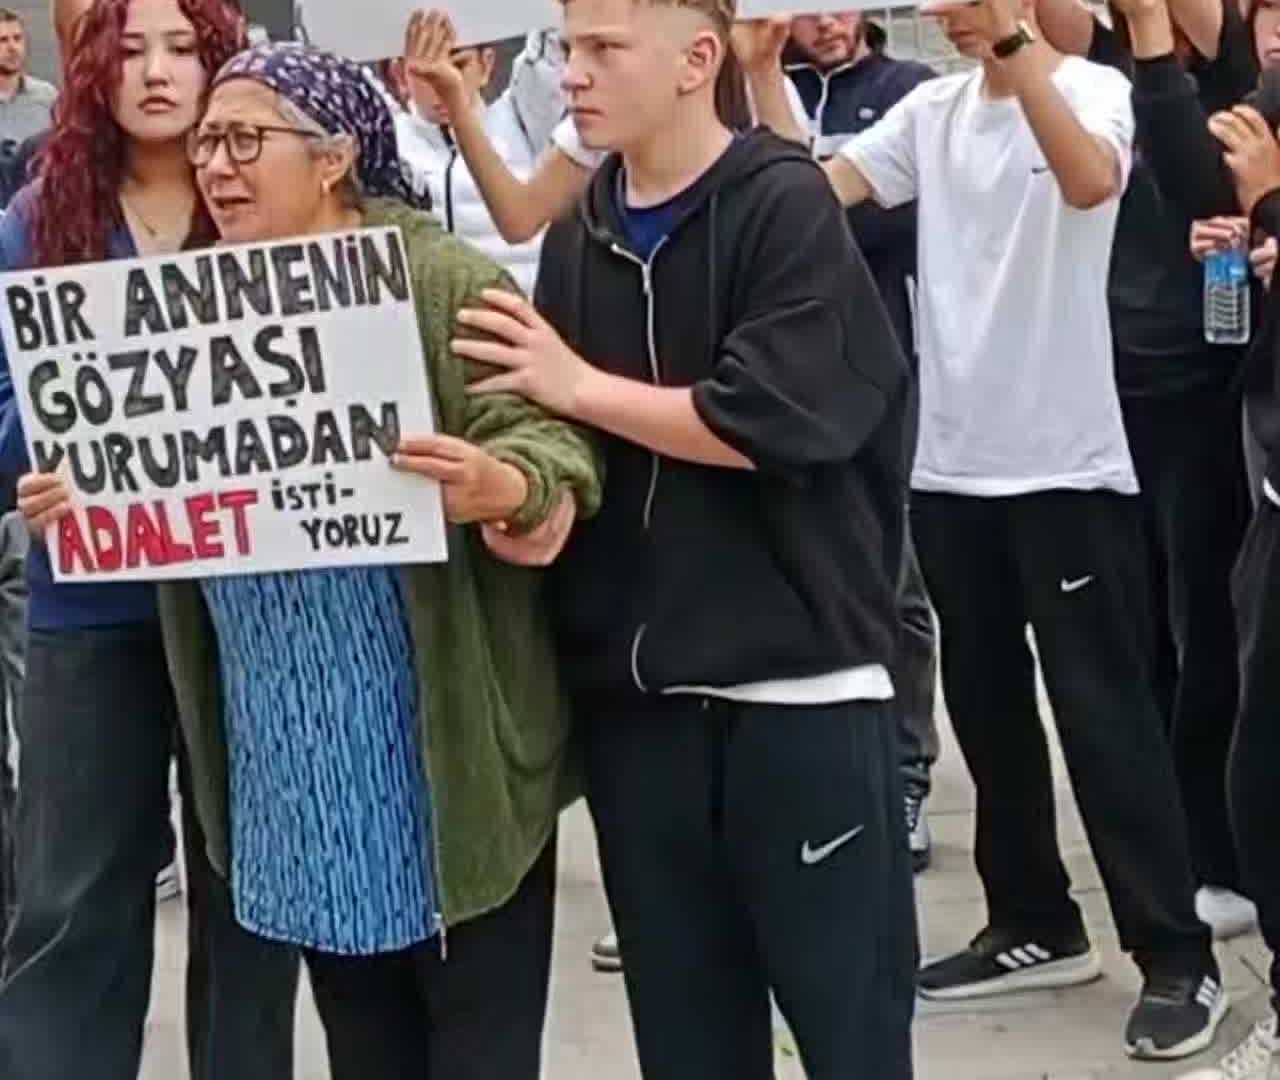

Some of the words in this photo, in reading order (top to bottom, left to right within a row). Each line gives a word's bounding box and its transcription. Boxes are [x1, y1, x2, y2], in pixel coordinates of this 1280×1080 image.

[6, 274, 94, 352] BİR
[123, 231, 410, 338] ANNENİN
[26, 324, 327, 435] GÖZYAŞI
[57, 488, 258, 576] ADALET
[300, 512, 409, 551] YORUZ
